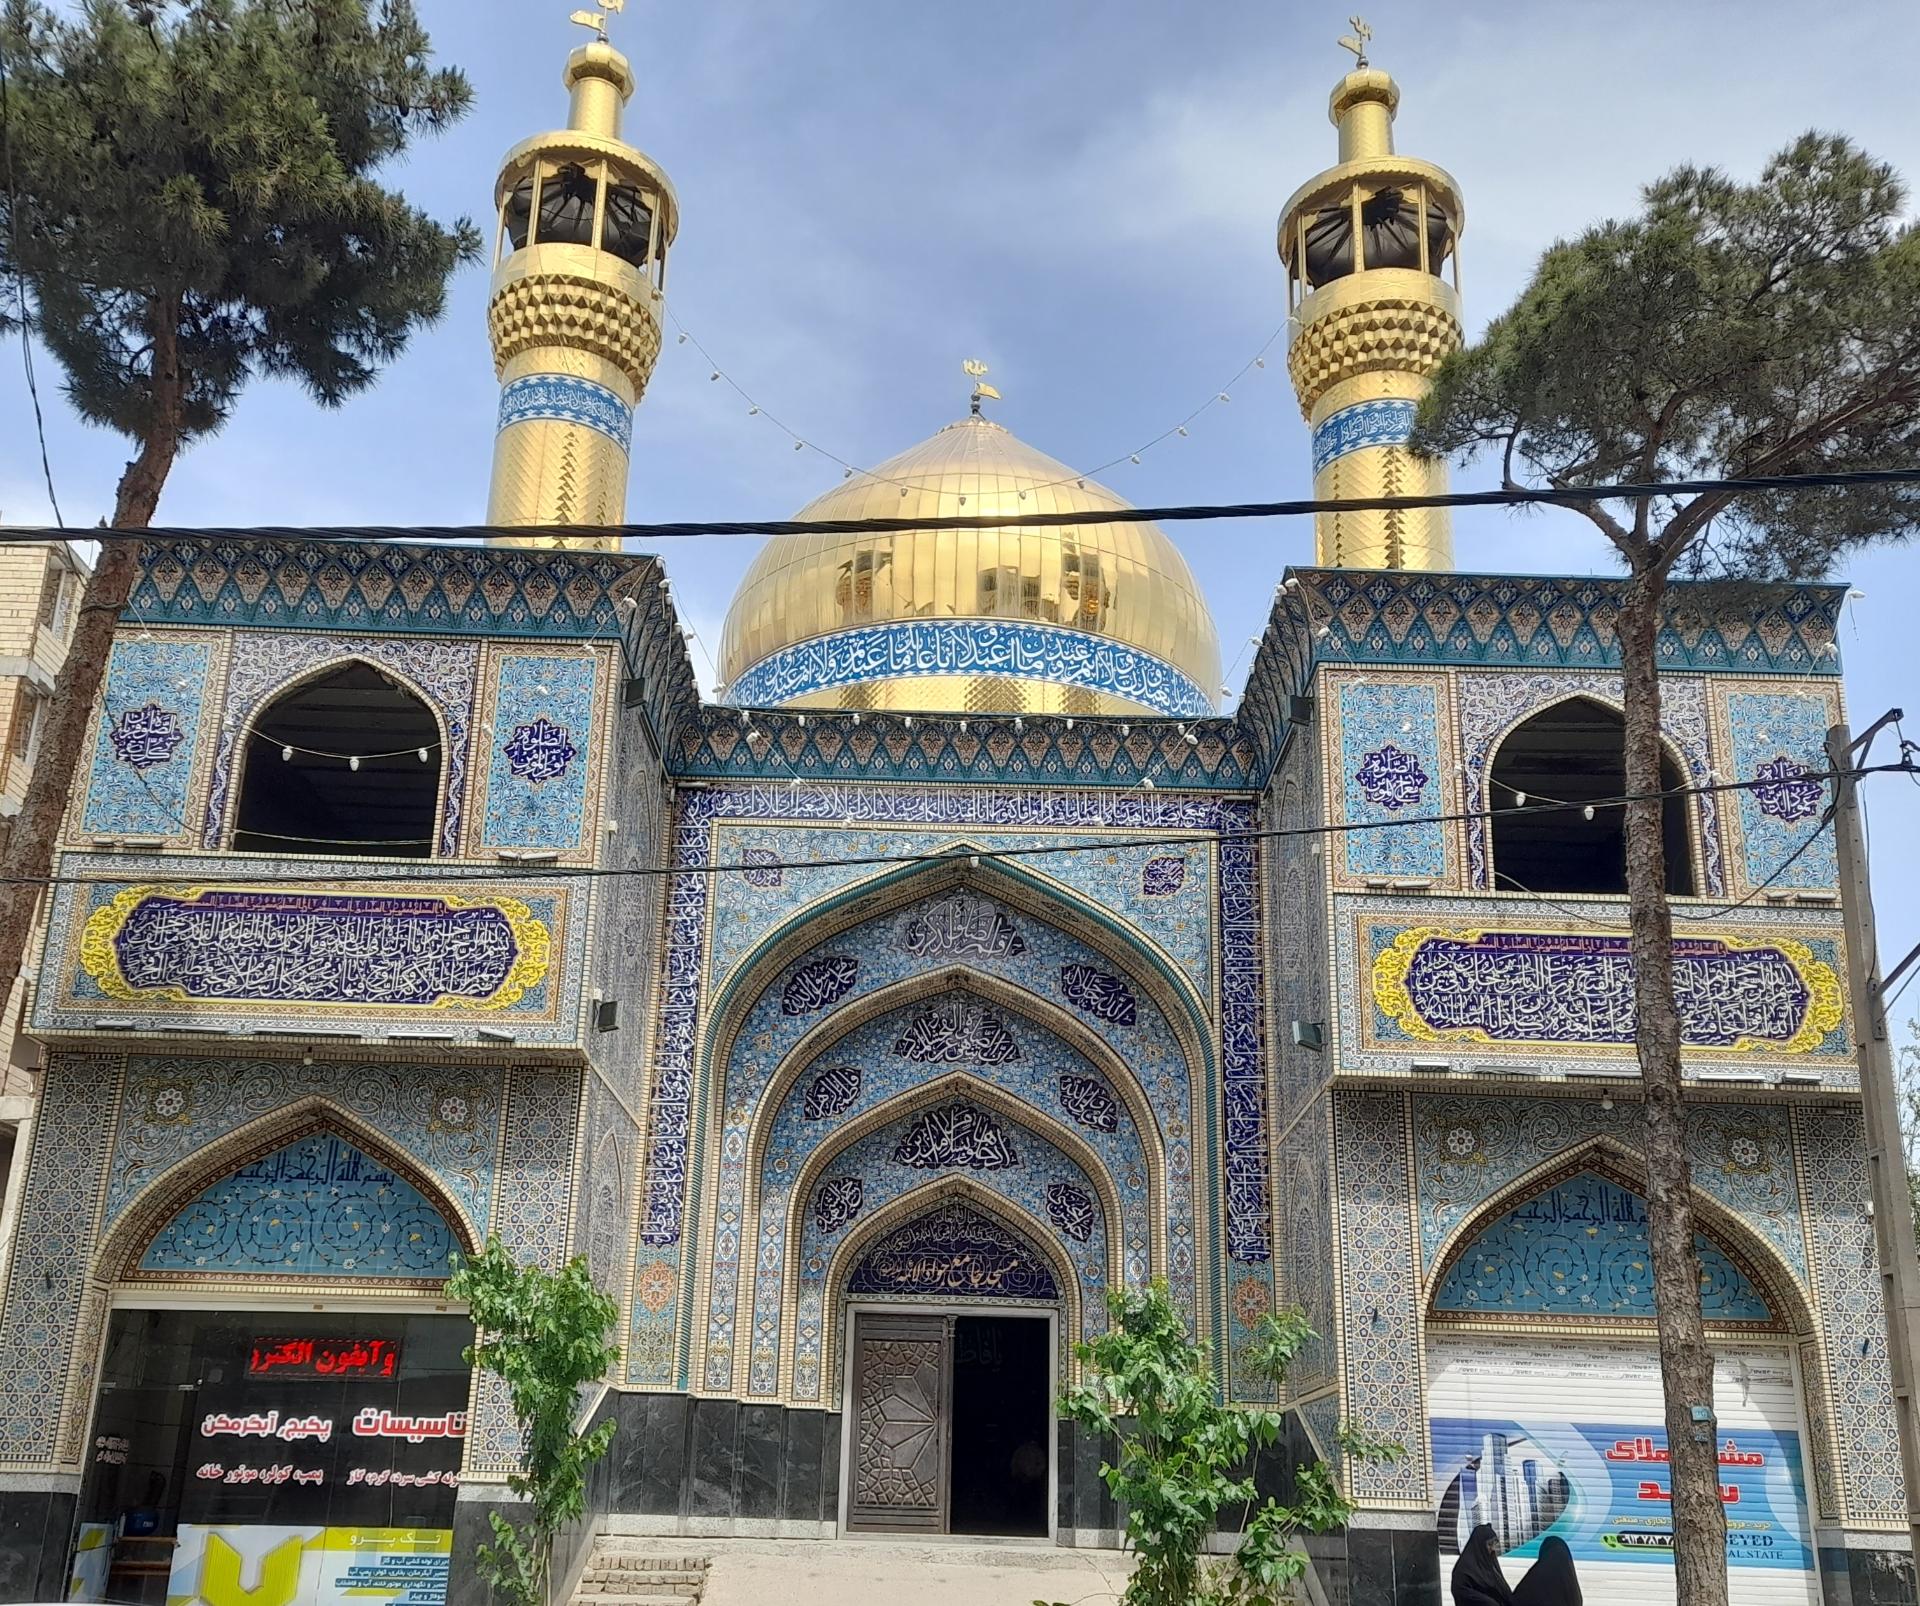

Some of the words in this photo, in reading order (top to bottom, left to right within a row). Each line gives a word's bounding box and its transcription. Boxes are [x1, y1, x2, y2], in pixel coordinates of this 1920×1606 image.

[315, 1340, 386, 1375] آیفون
[379, 1351, 395, 1377] و
[1605, 1436, 1671, 1463] ملاک
[196, 1463, 224, 1479] خانه
[223, 1464, 259, 1484] موتور
[414, 1470, 441, 1487] کشی
[1727, 1534, 1774, 1547] EYED
[1747, 1551, 1785, 1560] STATE
